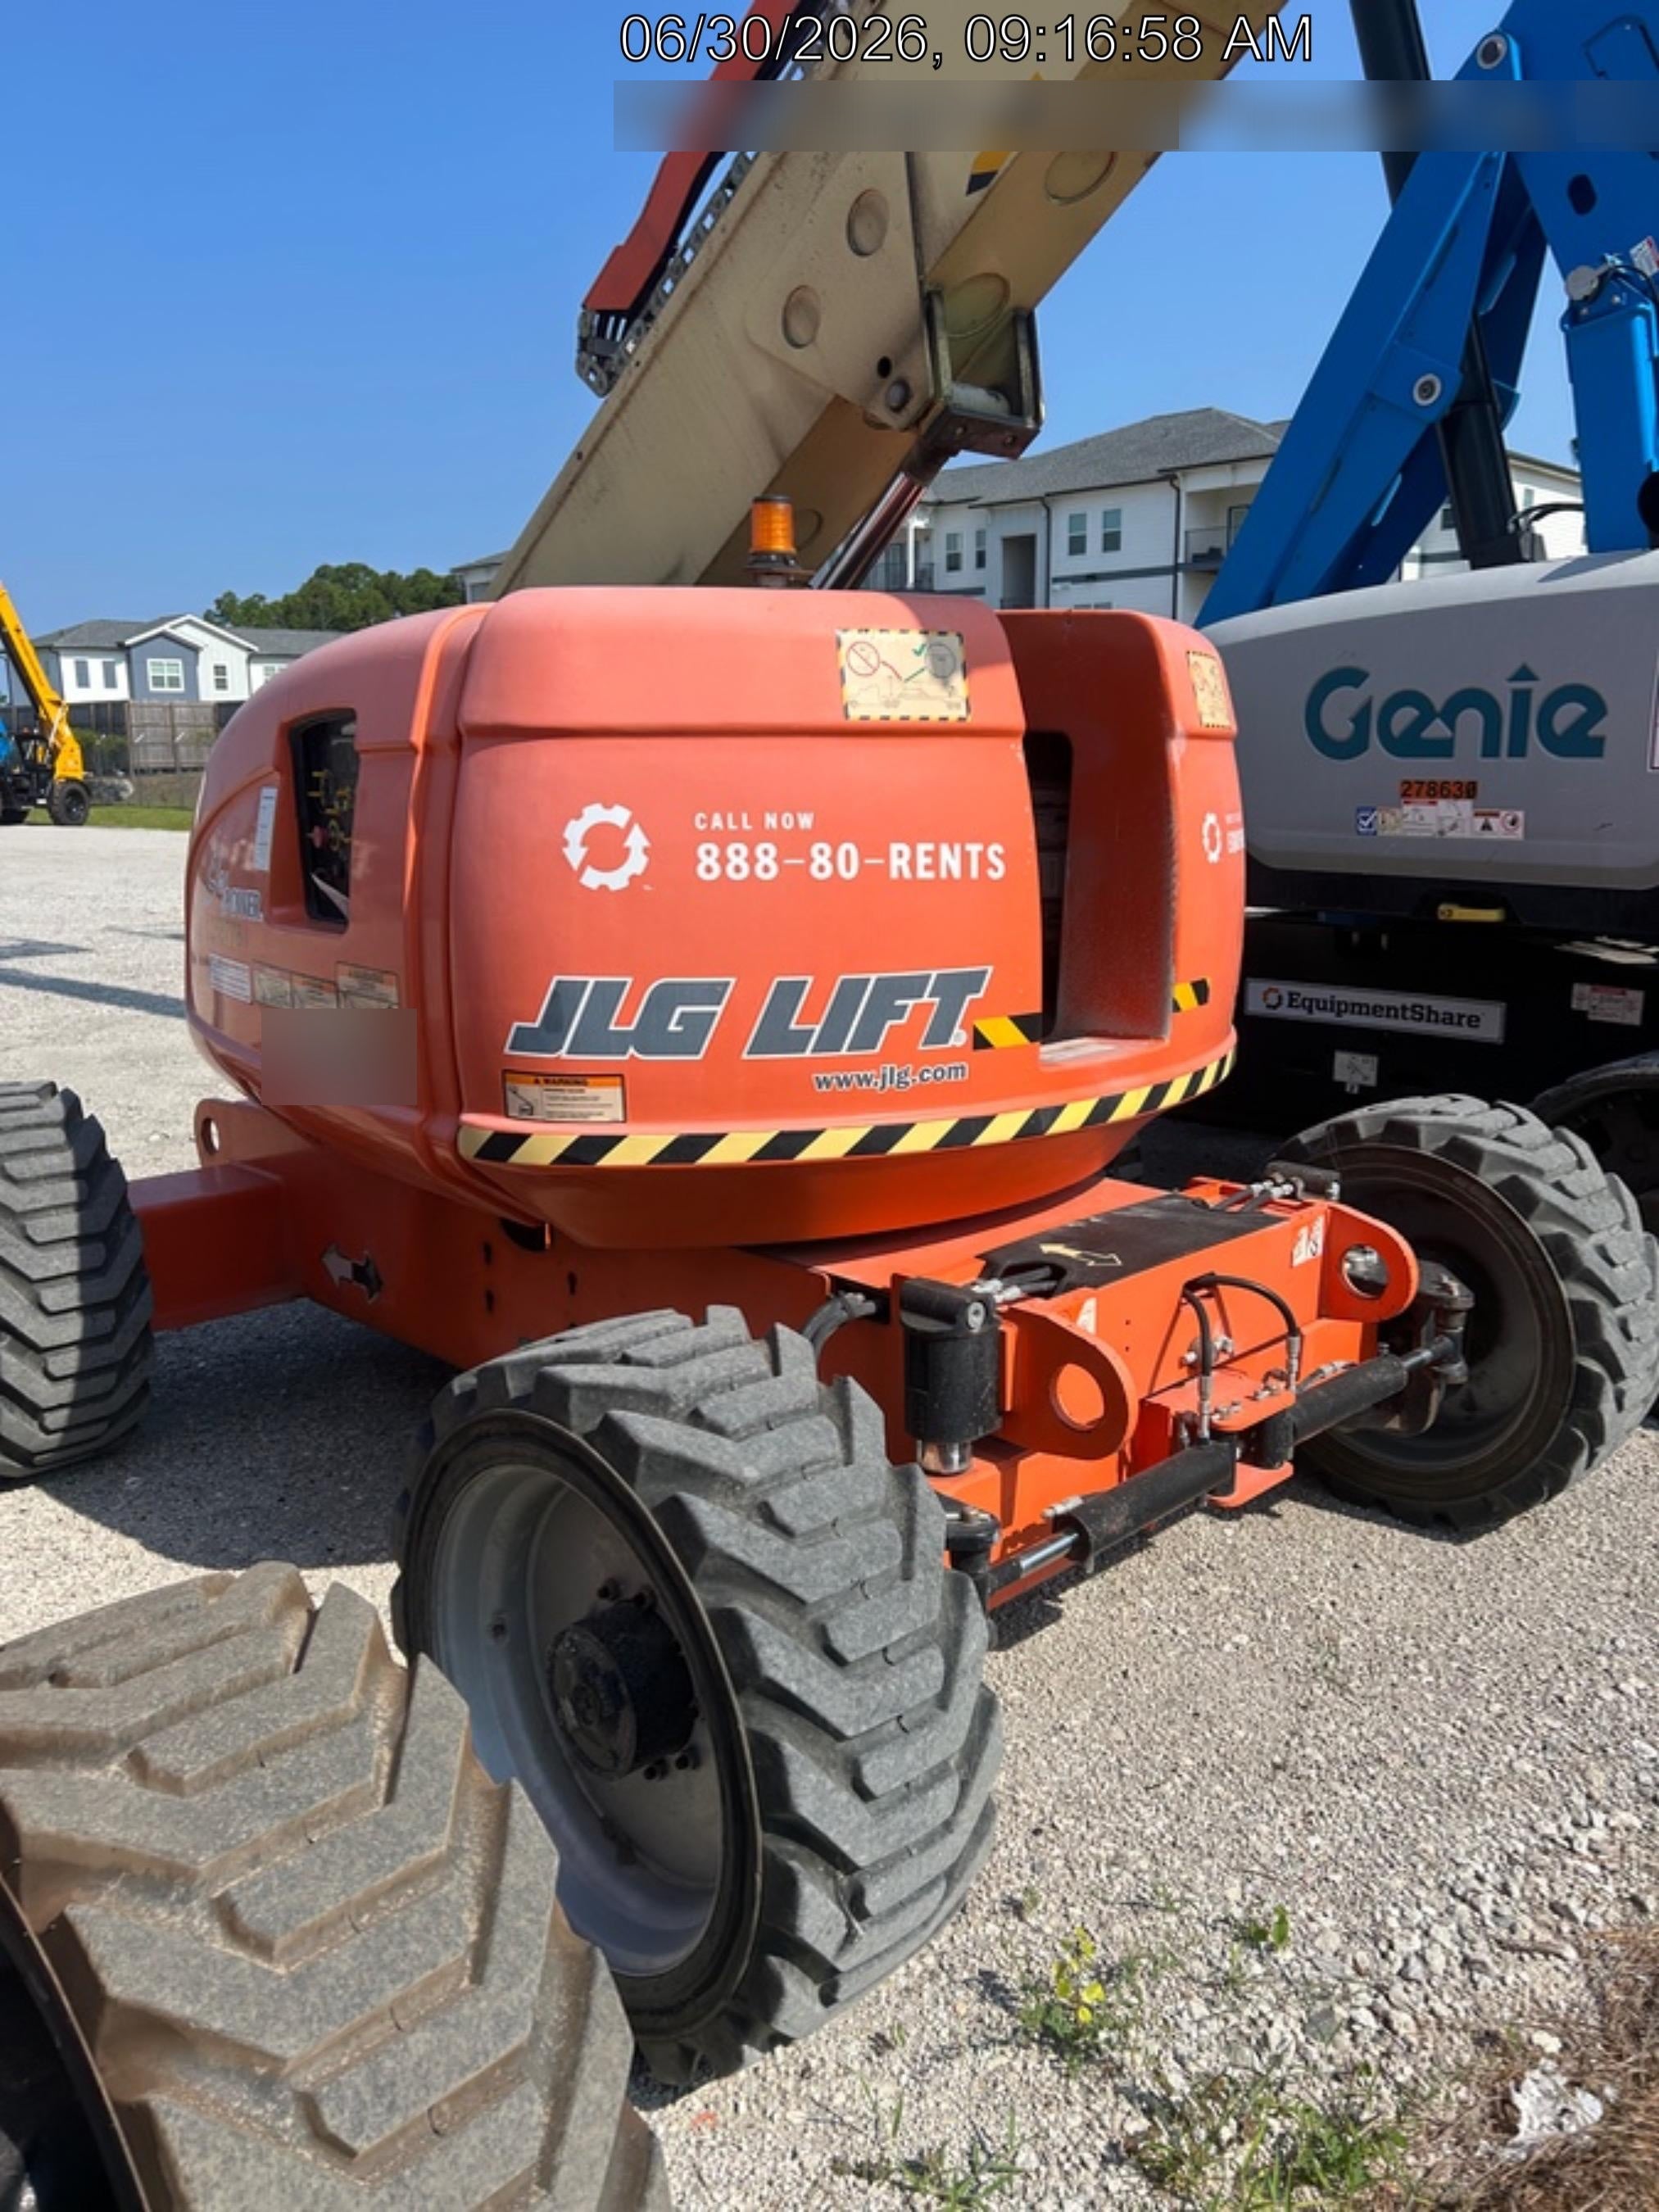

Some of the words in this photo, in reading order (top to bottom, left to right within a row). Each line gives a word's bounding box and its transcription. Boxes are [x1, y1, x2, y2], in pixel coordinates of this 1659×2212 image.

[1304, 662, 1609, 760] Genie
[1400, 780, 1478, 800] 278630
[695, 813, 753, 831] CALL
[764, 813, 815, 831] NOW
[696, 841, 1007, 881] 888-80-RENTS
[504, 975, 737, 1060] JLG
[741, 965, 994, 1058] LIFT
[1286, 990, 1482, 1030] EquipmentShare
[814, 1063, 968, 1092] www.jlg.com
